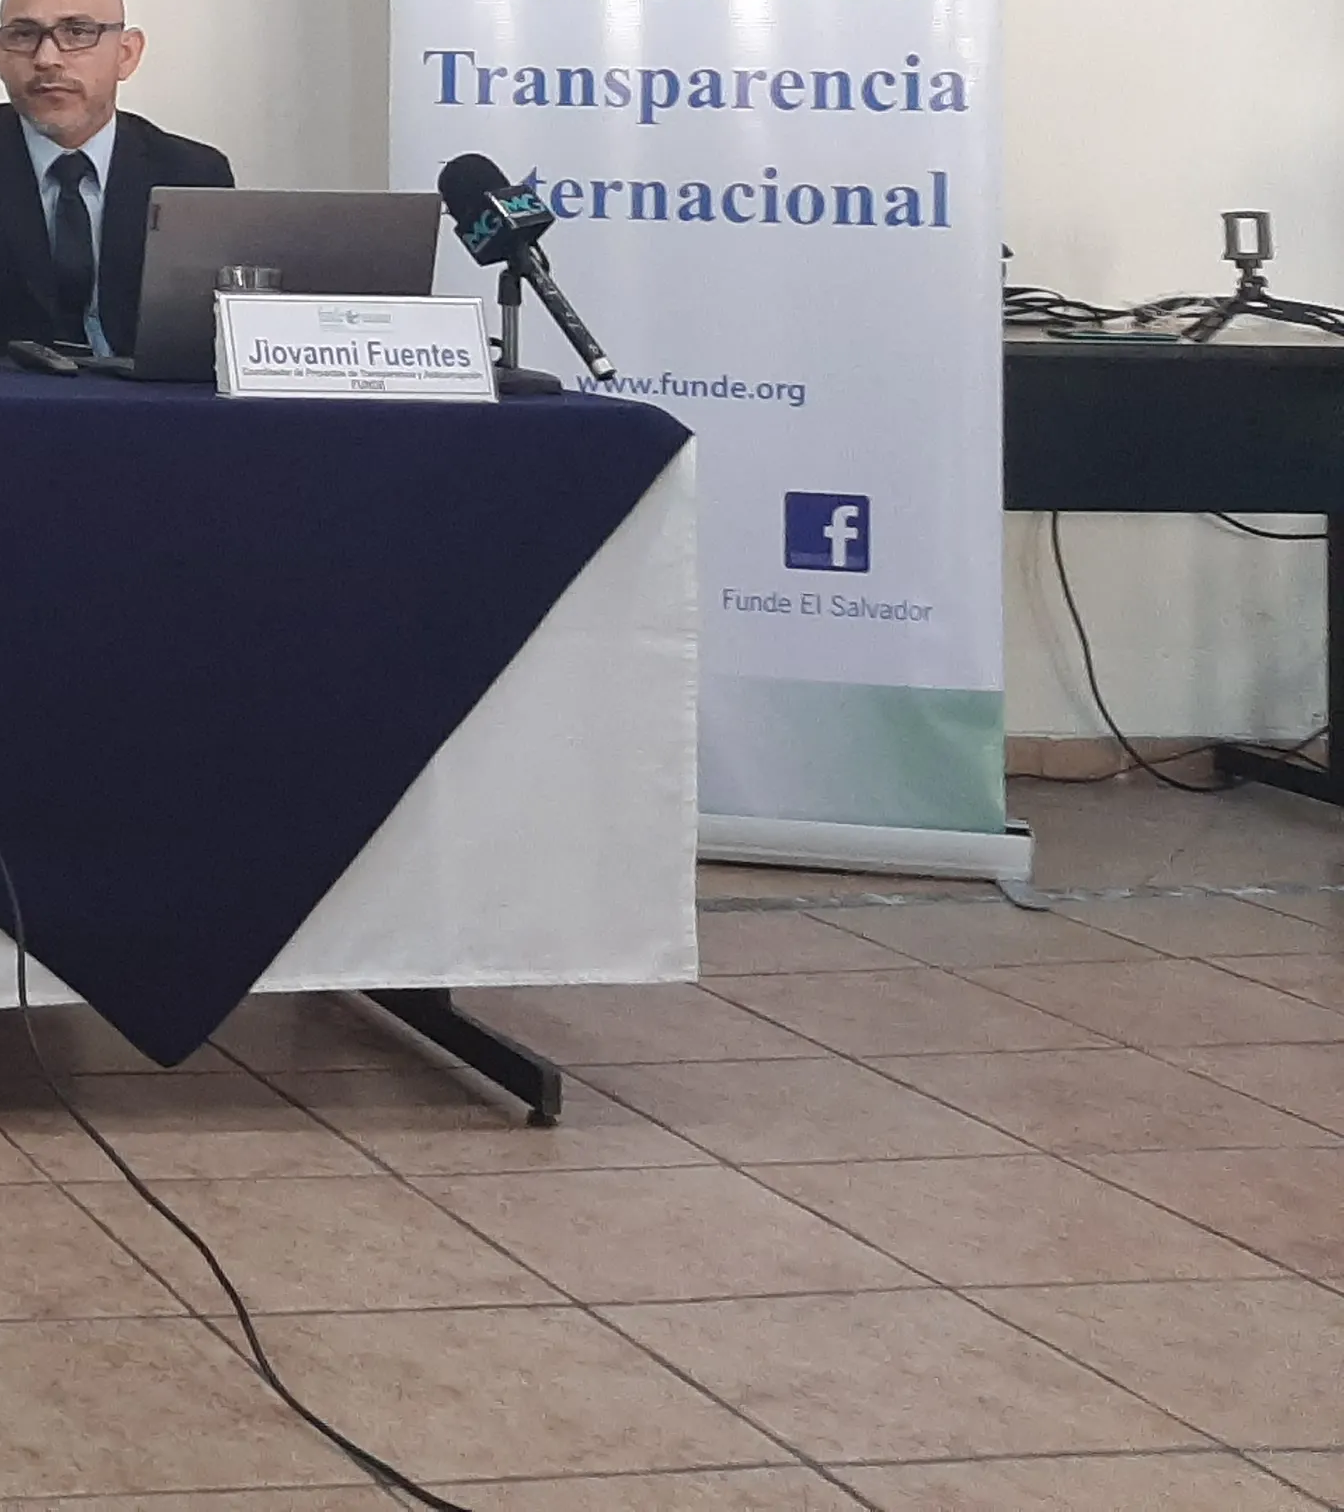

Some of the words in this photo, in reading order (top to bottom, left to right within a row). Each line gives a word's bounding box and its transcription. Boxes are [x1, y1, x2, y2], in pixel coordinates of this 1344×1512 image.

[422, 49, 970, 125] Transparencia
[248, 339, 359, 366] Jiovanni
[367, 341, 471, 368] Fuentes
[576, 371, 807, 408] www.funde.org
[722, 588, 792, 614] Funde
[800, 593, 821, 615] El
[830, 595, 934, 622] Salvador
